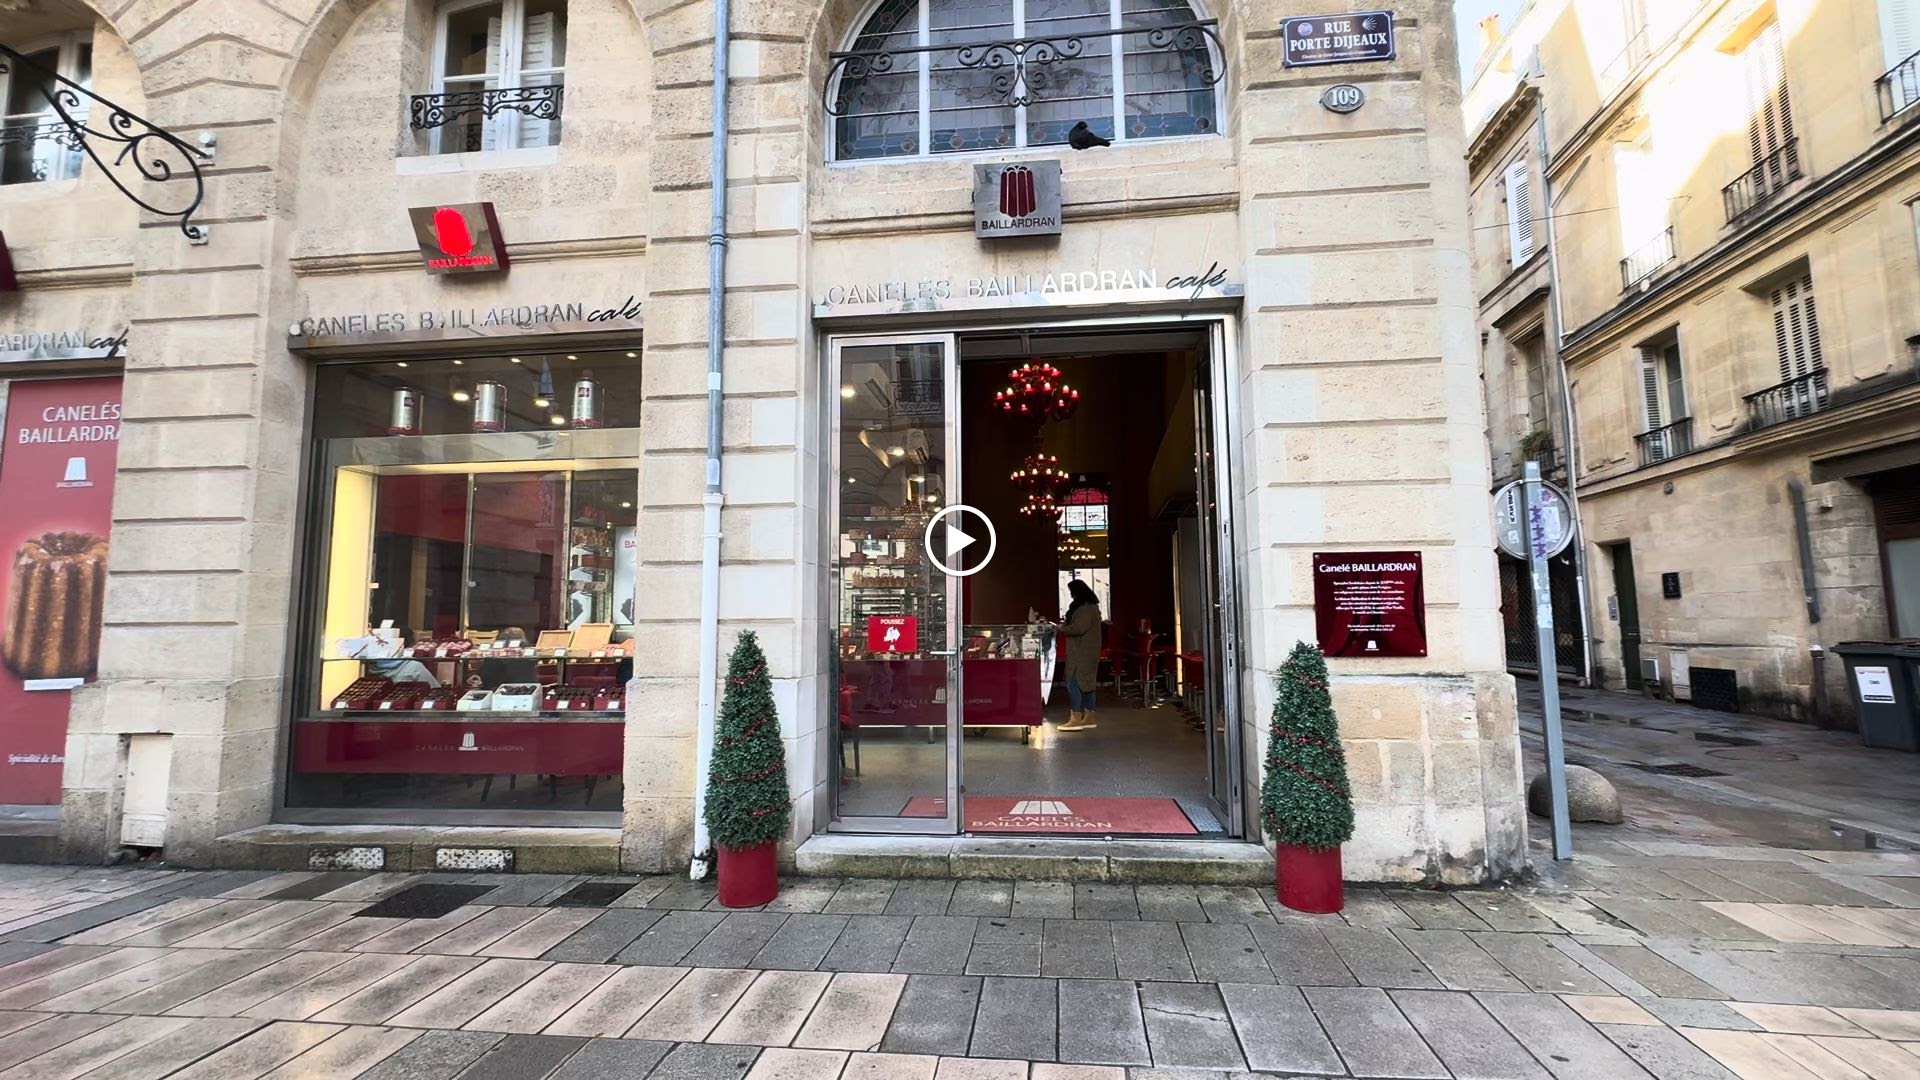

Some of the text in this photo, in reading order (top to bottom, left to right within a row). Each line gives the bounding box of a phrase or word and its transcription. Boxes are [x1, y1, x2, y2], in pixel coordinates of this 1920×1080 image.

[1324, 21, 1351, 34] RUE
[1290, 33, 1387, 51] PORTE DIJEAUX
[1331, 89, 1360, 106] 109
[981, 217, 1055, 230] BAILLARDRAN
[967, 269, 1158, 298] BAILLARDRAN
[1165, 261, 1228, 301] café
[42, 402, 121, 423] CANELÉS
[1319, 563, 1416, 573] Canelé BAILLARDRAN
[972, 820, 1112, 828] BAILLARDRAN
